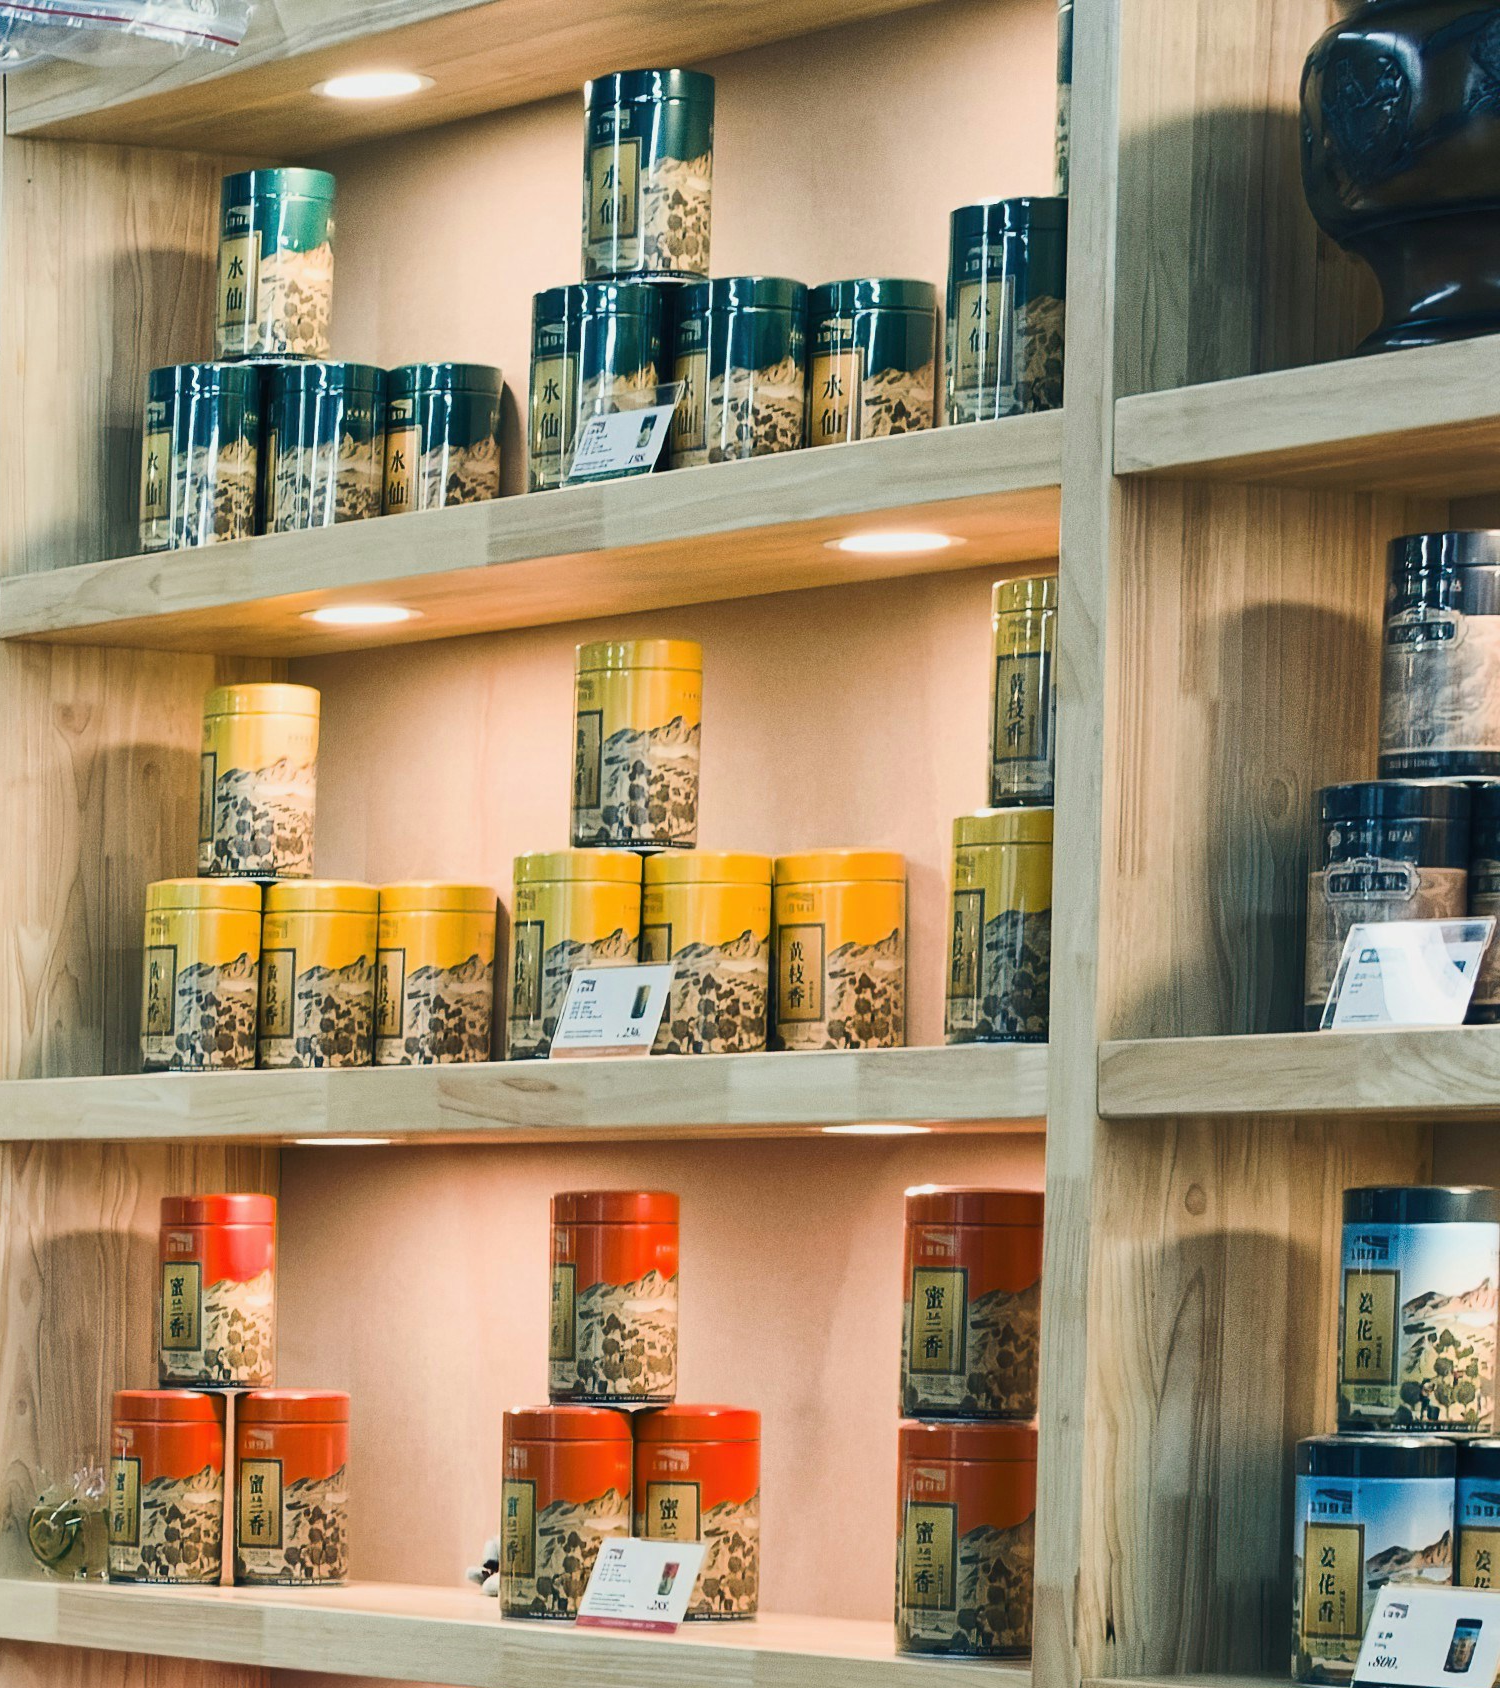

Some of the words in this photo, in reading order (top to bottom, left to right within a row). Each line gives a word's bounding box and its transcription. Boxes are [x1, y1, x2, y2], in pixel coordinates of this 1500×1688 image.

[226, 255, 244, 311] 水仙
[541, 378, 560, 440] 水仙
[821, 373, 844, 436] 水仙
[390, 449, 405, 506] 水仙
[788, 940, 805, 1009] 黄枝香
[924, 1284, 944, 1360] 蜜兰香
[914, 1520, 936, 1595] 蜜兰香
